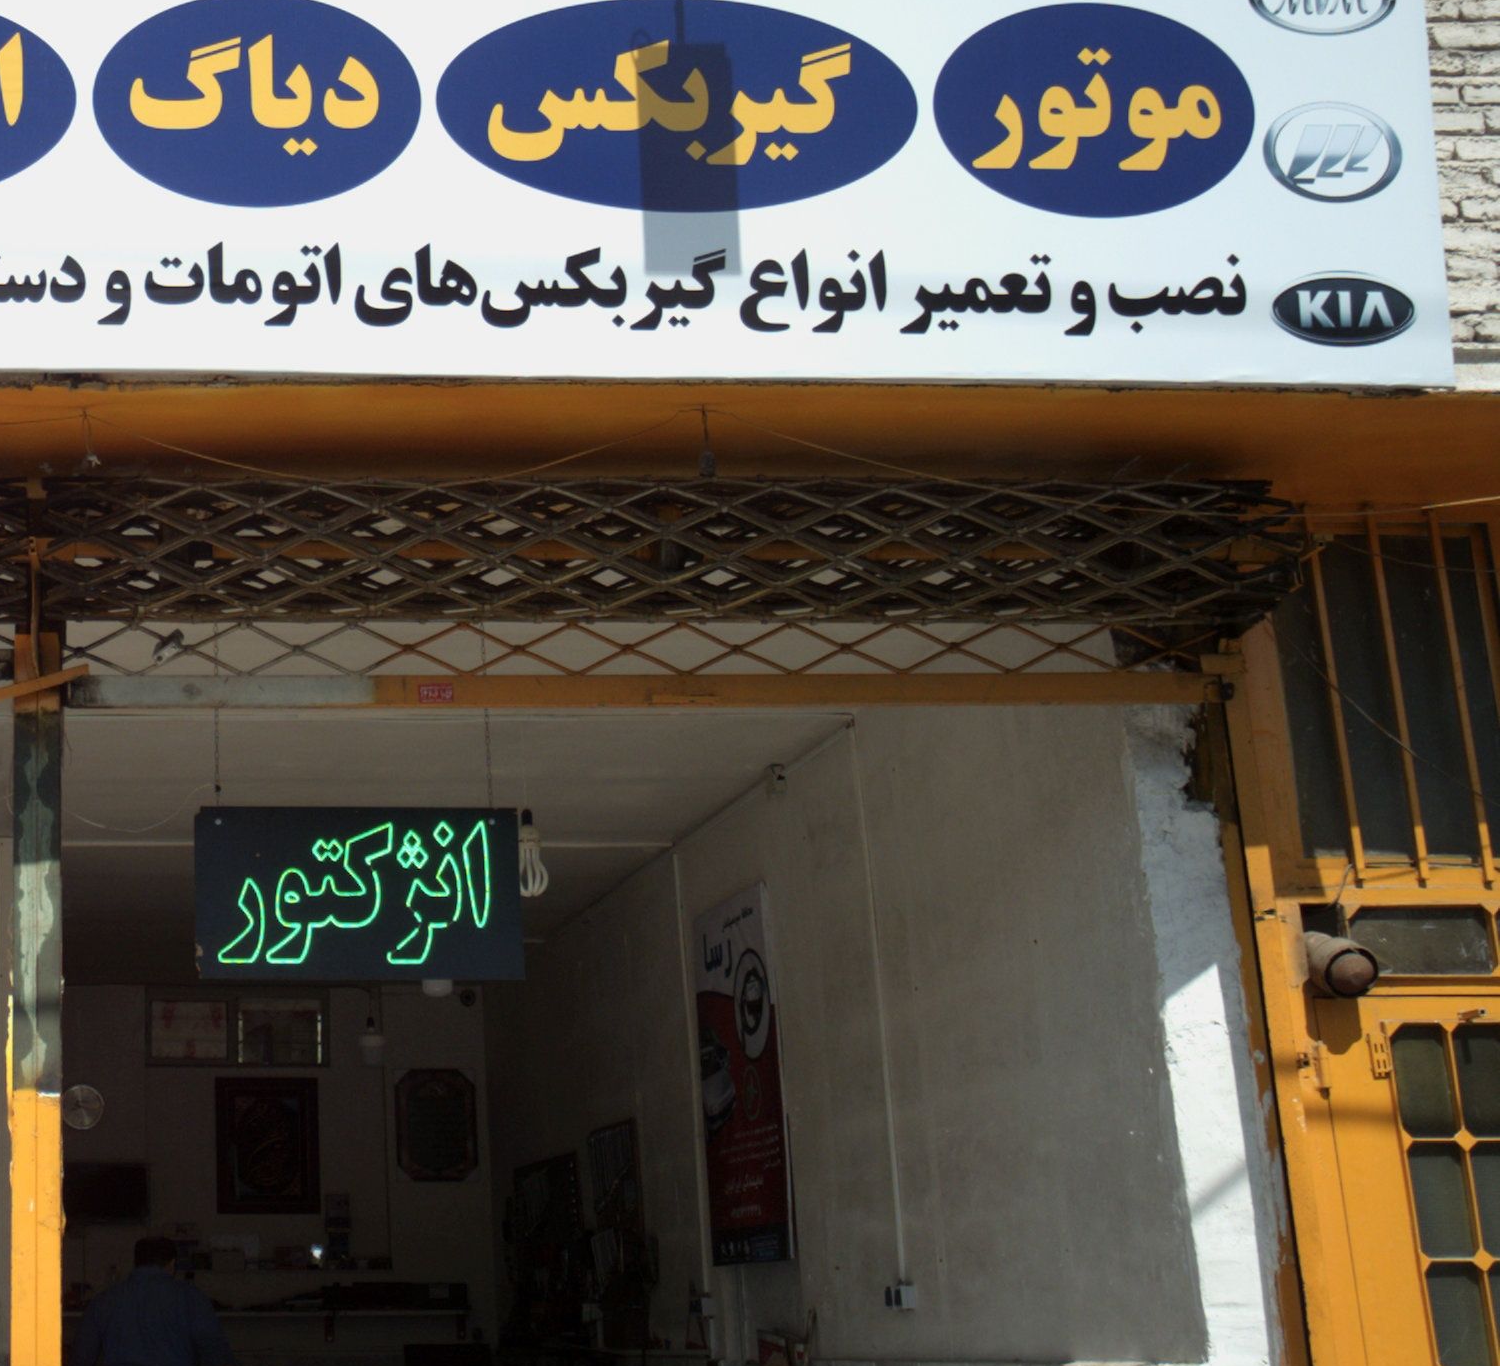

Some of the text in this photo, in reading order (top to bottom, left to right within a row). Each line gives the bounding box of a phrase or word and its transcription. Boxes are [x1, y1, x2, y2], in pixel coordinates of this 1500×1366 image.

[130, 34, 379, 155] دیاگ
[488, 40, 851, 165] گیربکس
[973, 48, 1221, 171] موتور
[97, 269, 132, 325] و
[144, 242, 342, 326] اتومات
[739, 248, 887, 333] انواع
[900, 254, 1052, 334] تعمیر
[1065, 280, 1097, 335] و
[1108, 254, 1247, 333] نصب
[1296, 290, 1395, 330] KIA
[217, 819, 492, 966] انژکتور
